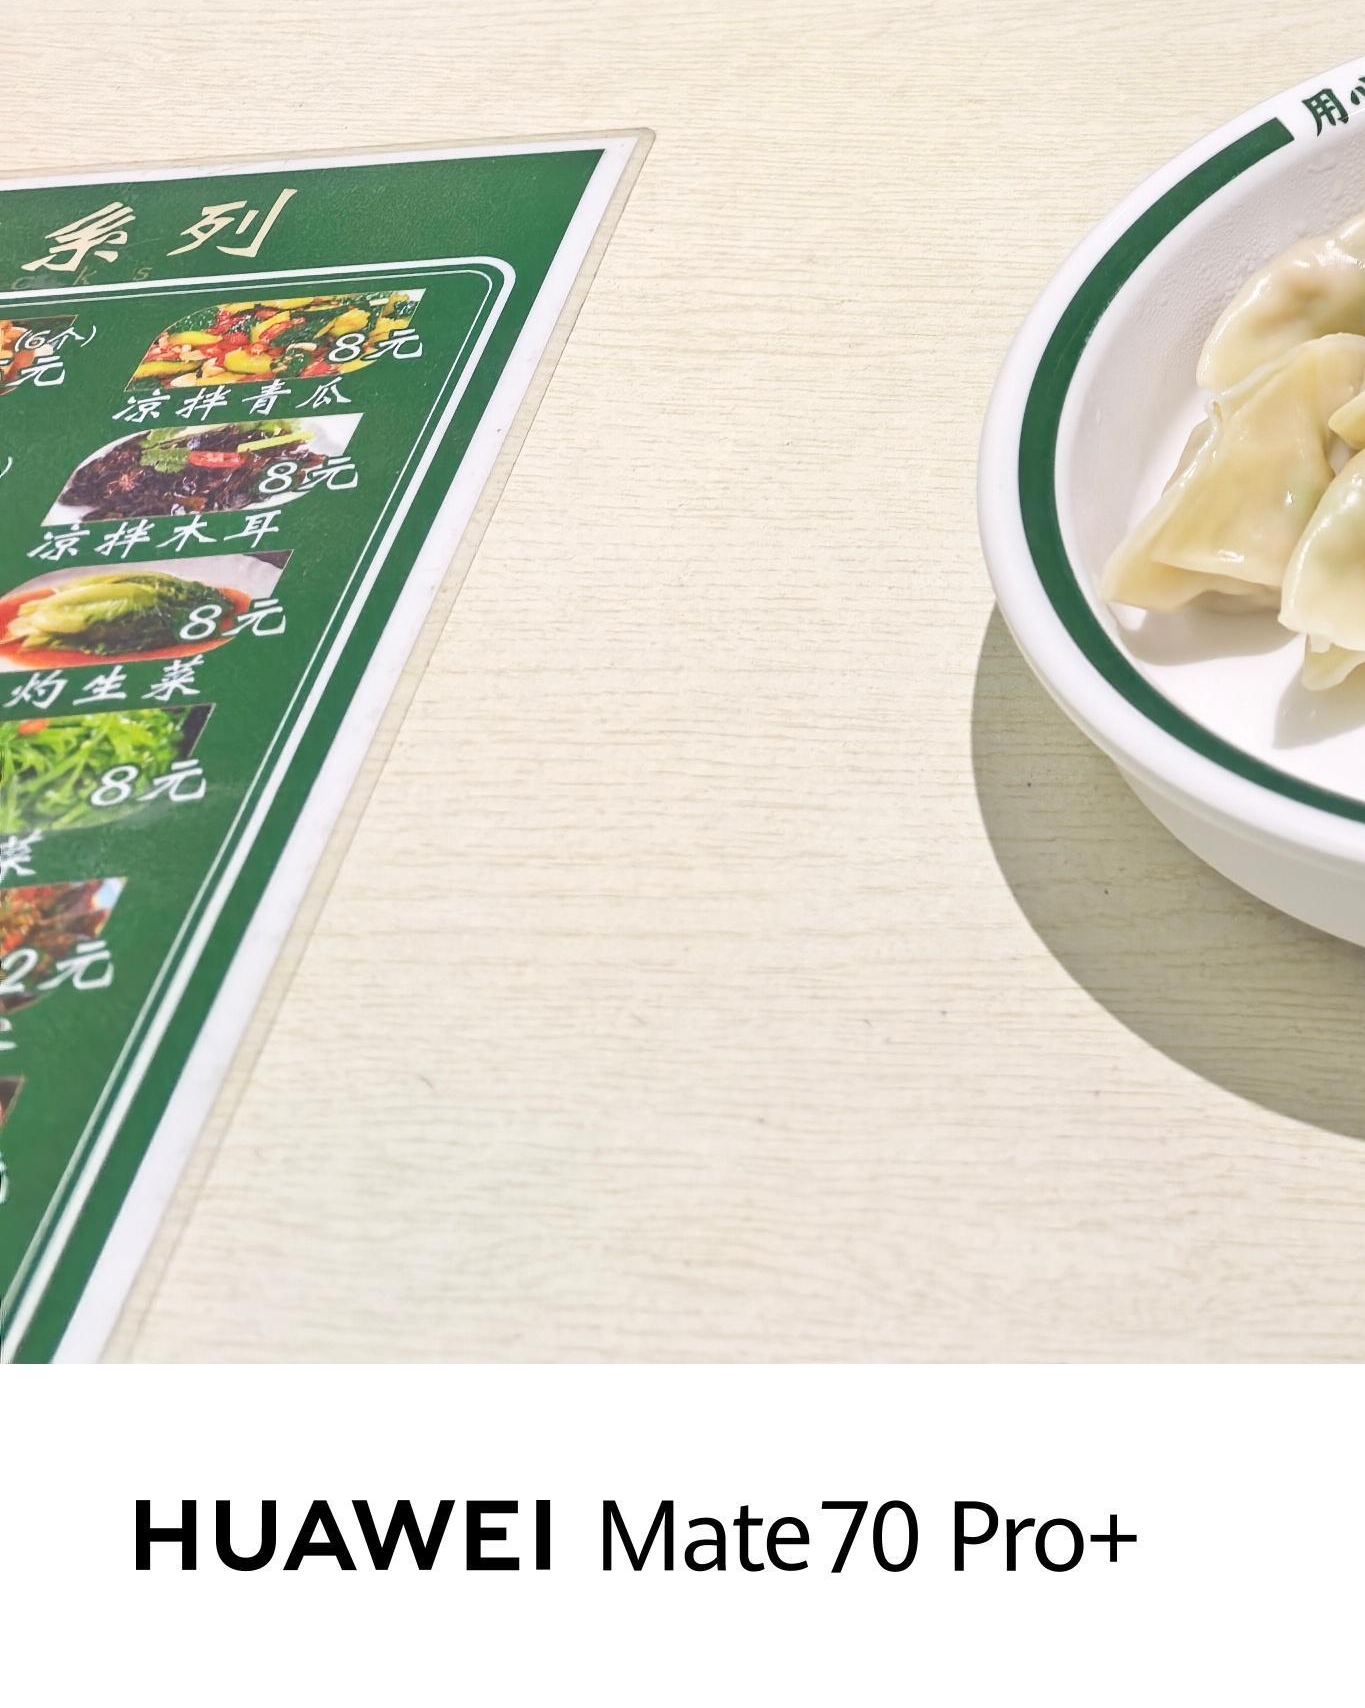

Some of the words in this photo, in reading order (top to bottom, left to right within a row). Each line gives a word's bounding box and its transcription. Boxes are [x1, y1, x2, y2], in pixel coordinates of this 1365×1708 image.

[21, 188, 298, 271] 系列
[328, 328, 424, 362] 8元
[112, 376, 352, 423] 凉拌青瓜
[258, 456, 359, 494] 8元
[27, 509, 282, 561] 凉拌木耳
[179, 598, 286, 640] 8元
[90, 759, 207, 807] 8元
